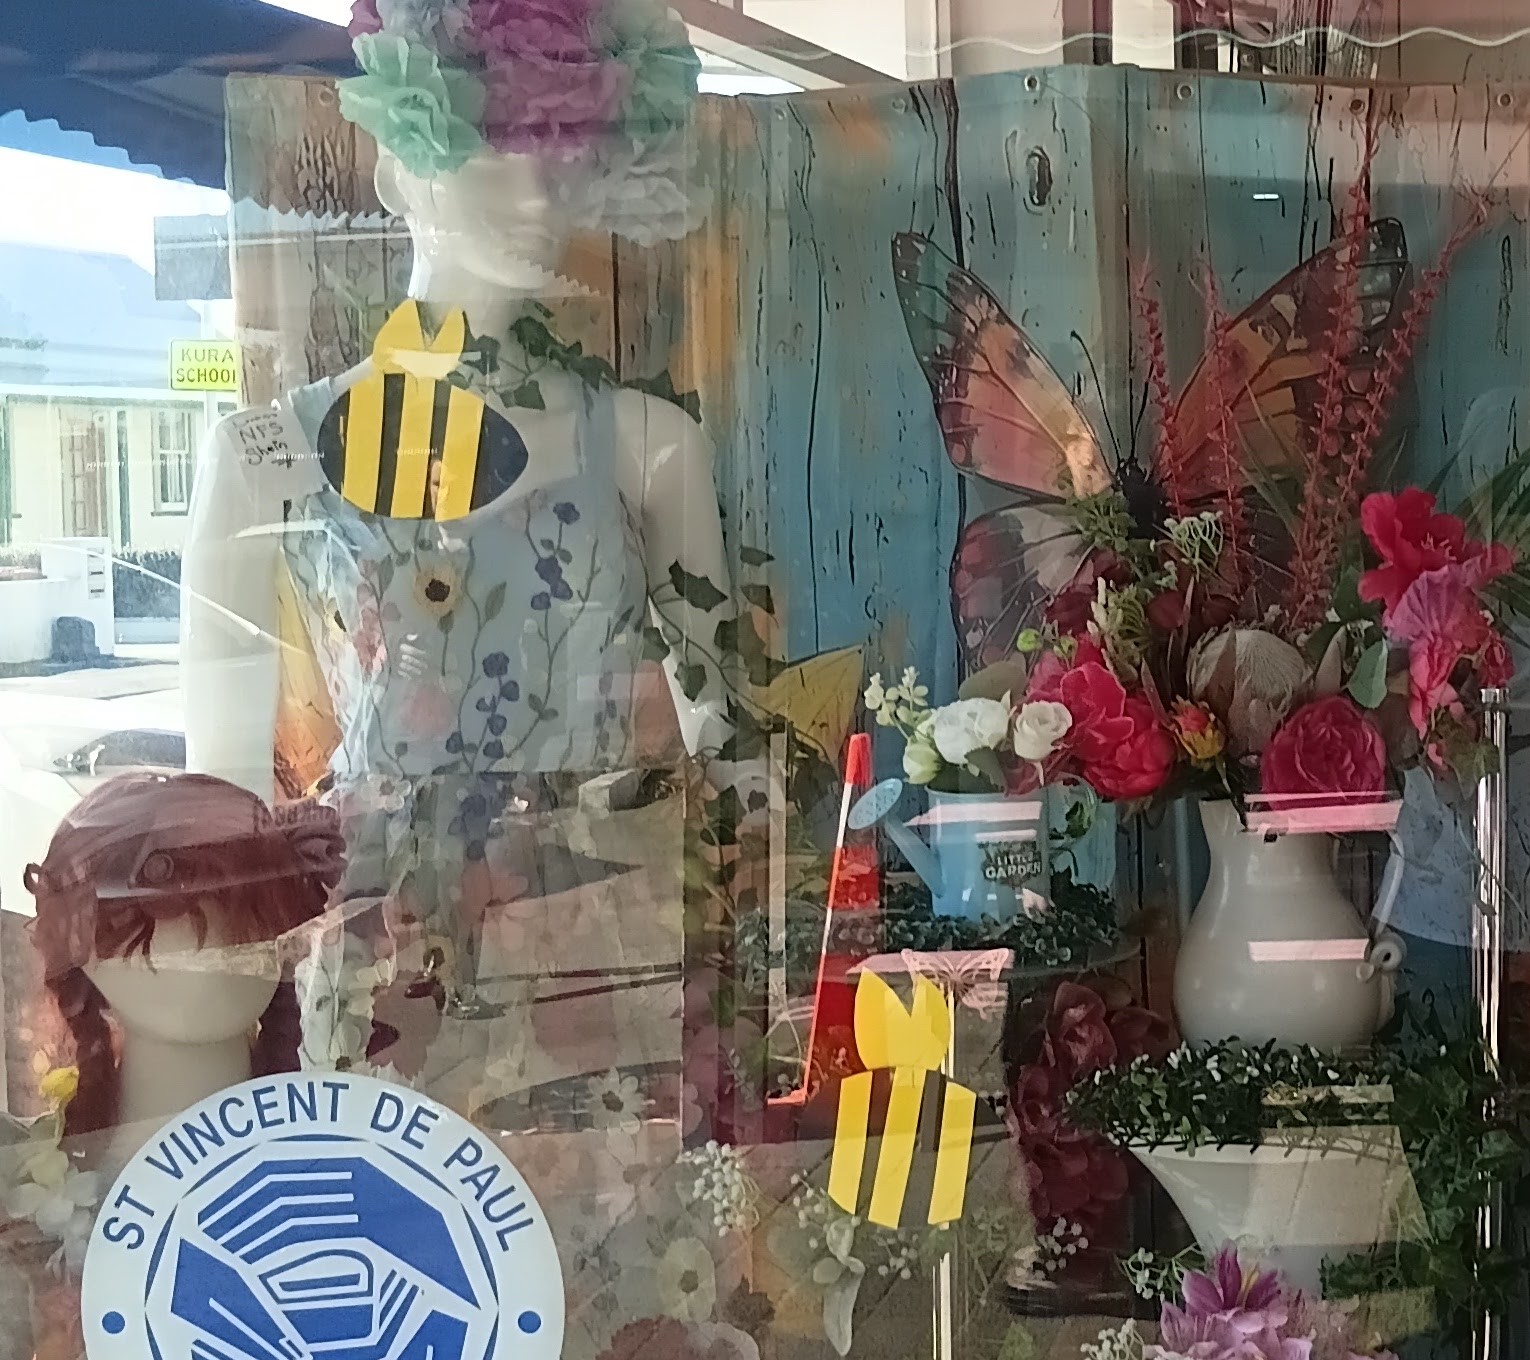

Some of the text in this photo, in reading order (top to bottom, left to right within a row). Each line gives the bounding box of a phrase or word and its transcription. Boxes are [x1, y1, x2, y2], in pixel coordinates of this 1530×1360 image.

[181, 347, 234, 363] KURA
[102, 1080, 535, 1253] ST VINCENT DE PAUL
